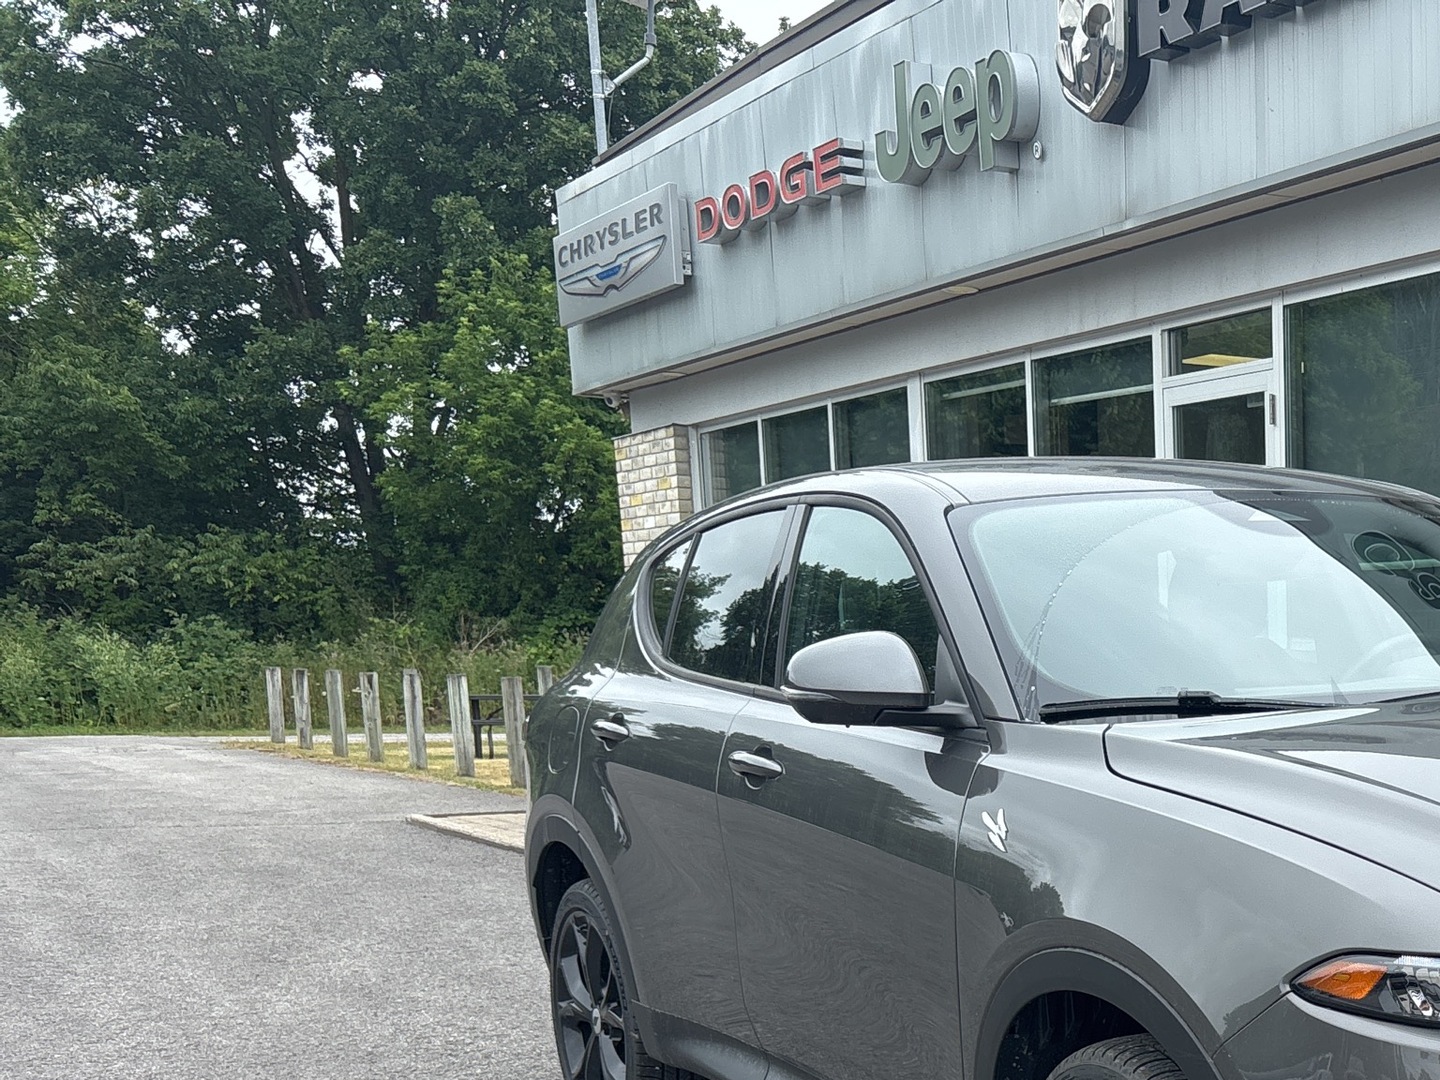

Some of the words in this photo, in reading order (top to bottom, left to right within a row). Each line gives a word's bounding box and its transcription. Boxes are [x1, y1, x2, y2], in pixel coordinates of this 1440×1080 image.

[875, 49, 1024, 184] Jeep
[558, 202, 664, 268] CHRYSLER
[695, 137, 848, 243] DODGE
